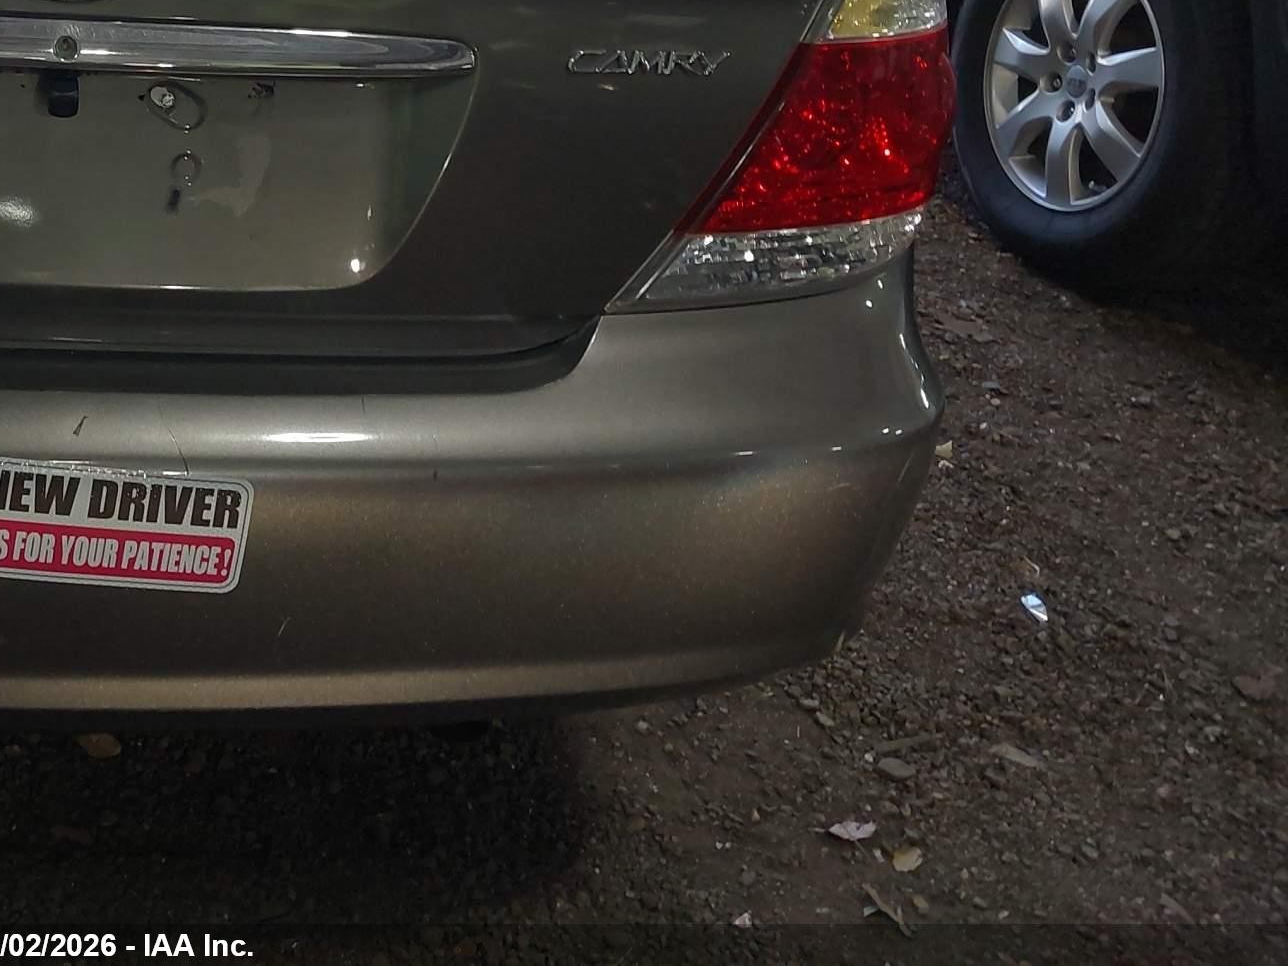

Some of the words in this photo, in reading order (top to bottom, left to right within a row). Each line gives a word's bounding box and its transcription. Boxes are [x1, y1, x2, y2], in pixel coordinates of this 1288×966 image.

[568, 49, 732, 75] CAMRY
[87, 478, 241, 530] DRIVER
[12, 531, 56, 564] FOR
[61, 535, 119, 569] YOUR
[121, 540, 232, 577] PATIENCE!
